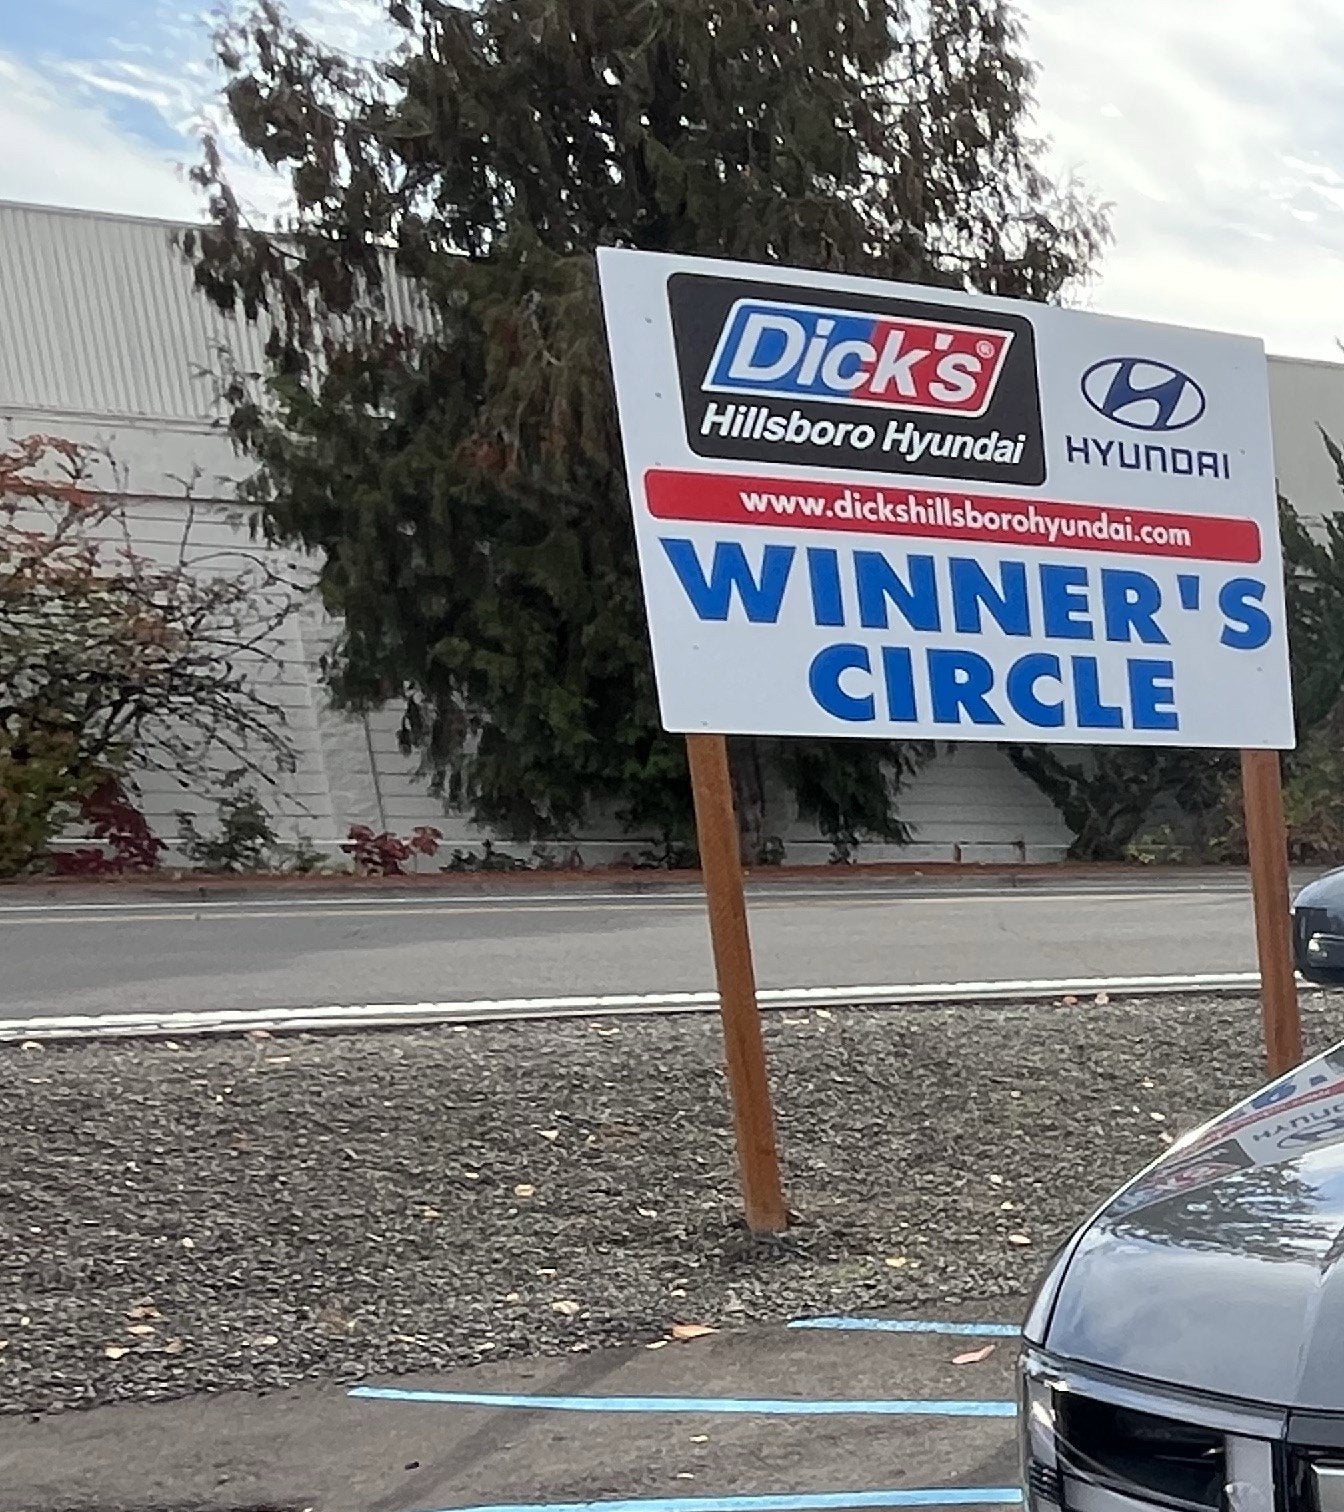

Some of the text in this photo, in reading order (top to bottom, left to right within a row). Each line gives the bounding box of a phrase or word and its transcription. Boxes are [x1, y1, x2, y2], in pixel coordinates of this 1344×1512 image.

[700, 403, 1027, 465] Hillsboro Hyundai
[1066, 434, 1231, 480] HYUNDAI
[740, 487, 1192, 548] www.dickshillsborohyundai.com
[658, 538, 1273, 651] WINNER'S
[808, 642, 1180, 731] CIRCLE
